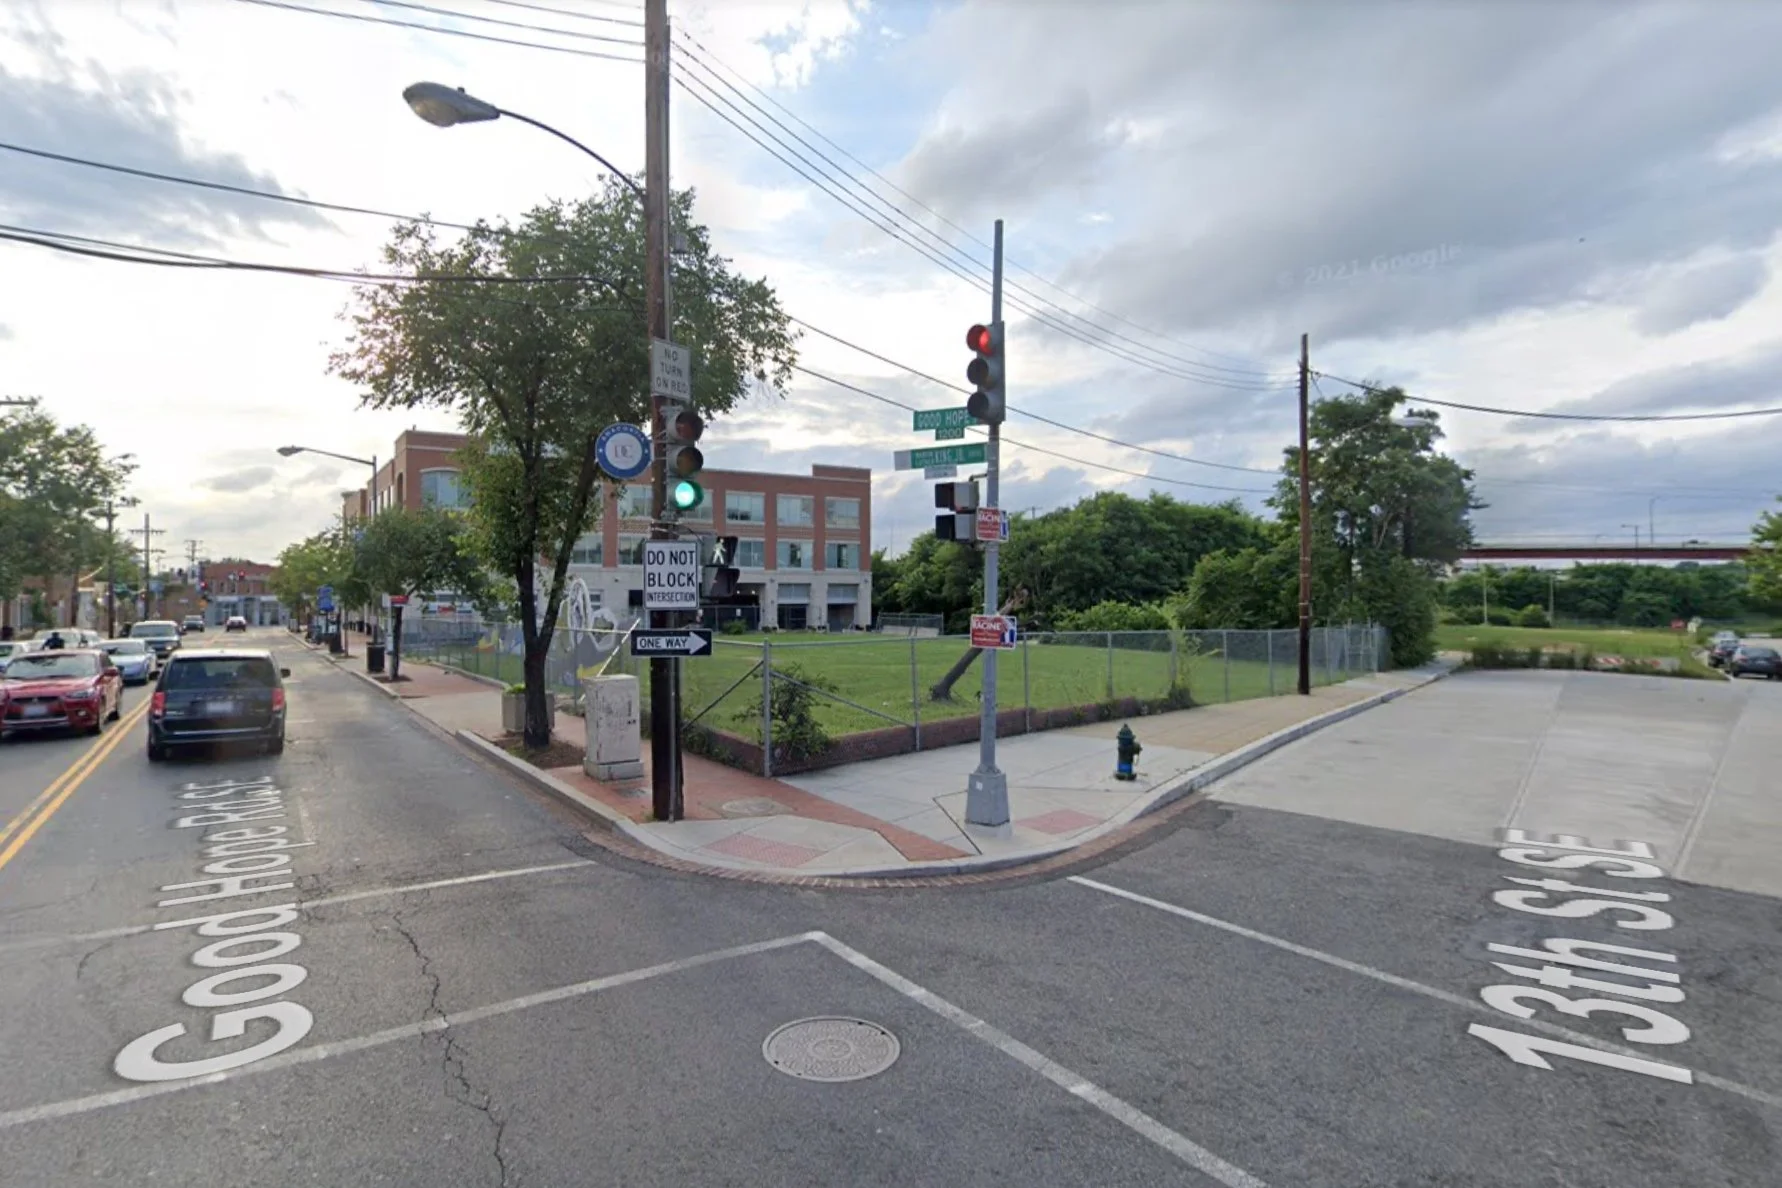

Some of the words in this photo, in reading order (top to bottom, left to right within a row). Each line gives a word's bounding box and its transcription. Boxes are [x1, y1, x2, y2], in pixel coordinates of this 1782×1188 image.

[664, 347, 678, 361] NO
[660, 361, 683, 377] TURN
[656, 376, 668, 388] ON
[671, 380, 689, 394] RED
[918, 411, 941, 428] GOOD
[945, 409, 971, 426] HOPE
[938, 427, 961, 438] 1200
[647, 550, 665, 565] DO
[670, 550, 695, 565] NOT
[647, 572, 695, 588] BLOCK
[647, 592, 696, 602] INTERSECTION
[972, 619, 1001, 631] RACINE
[640, 638, 661, 648] ONE
[665, 637, 688, 648] WAY
